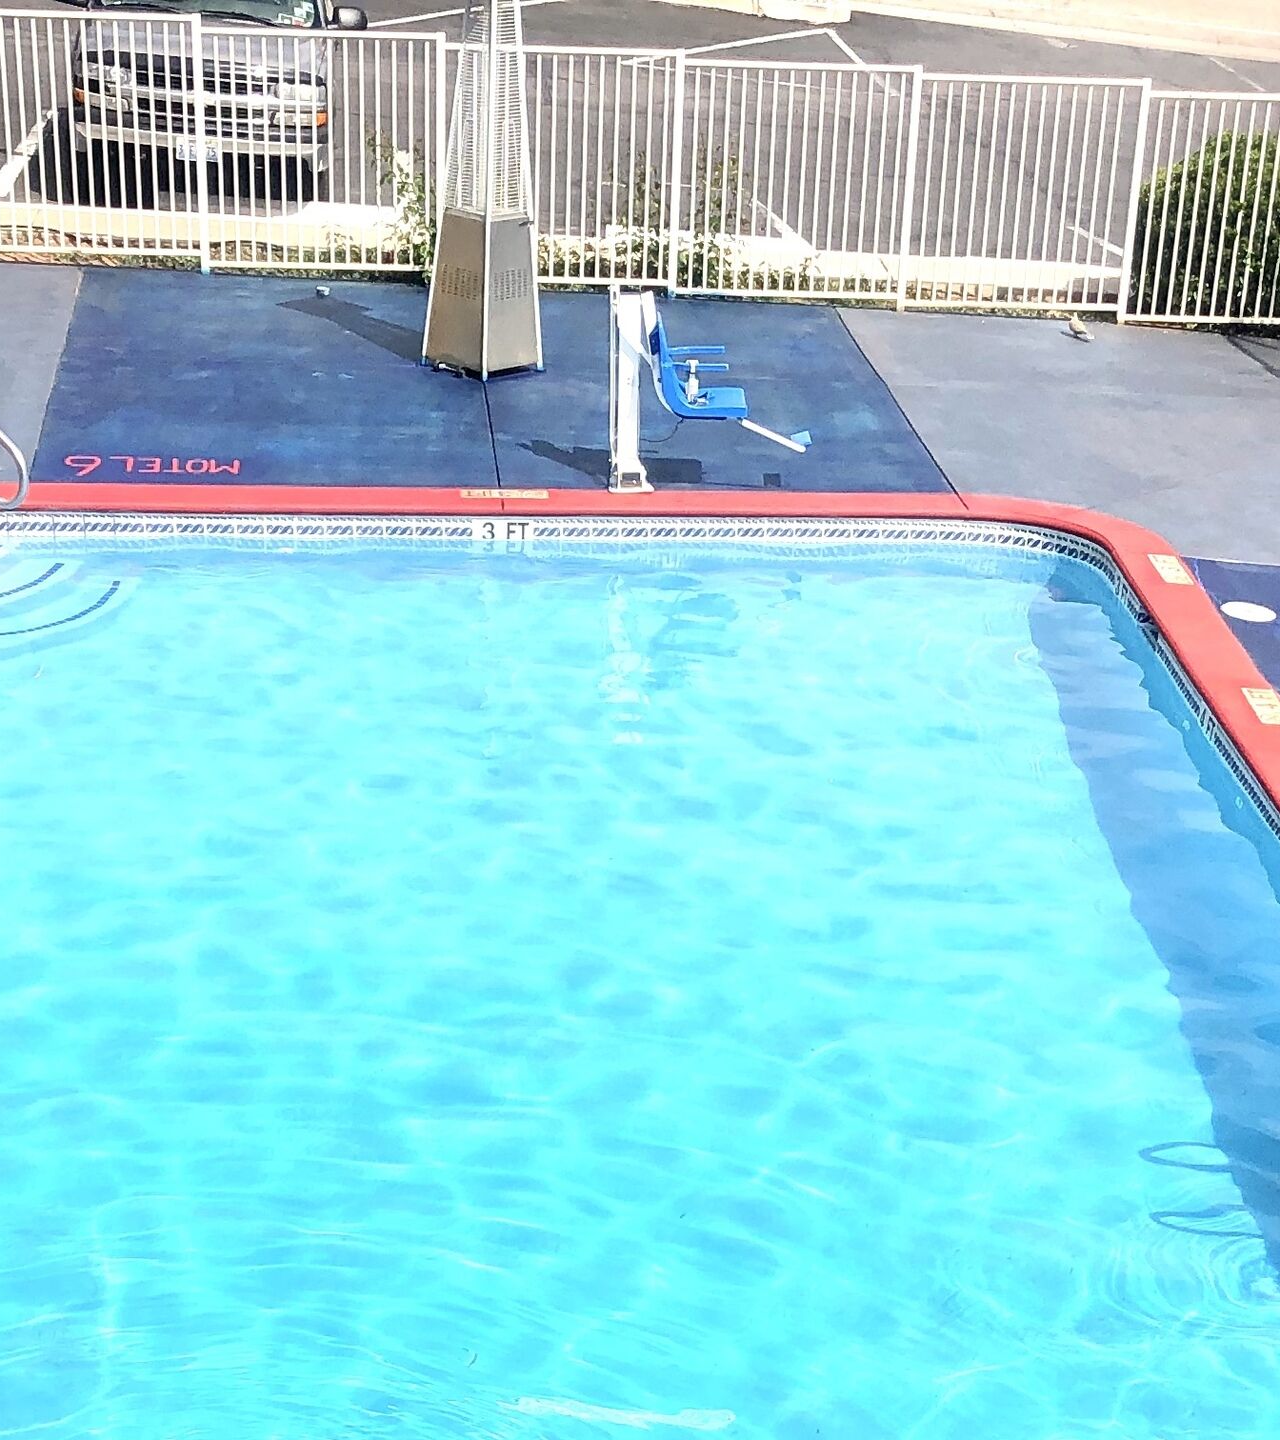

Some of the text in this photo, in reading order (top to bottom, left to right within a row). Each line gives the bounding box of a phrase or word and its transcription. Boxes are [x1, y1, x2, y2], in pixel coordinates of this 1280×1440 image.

[64, 454, 241, 476] MOTEL 6
[482, 522, 530, 540] 3 FT
